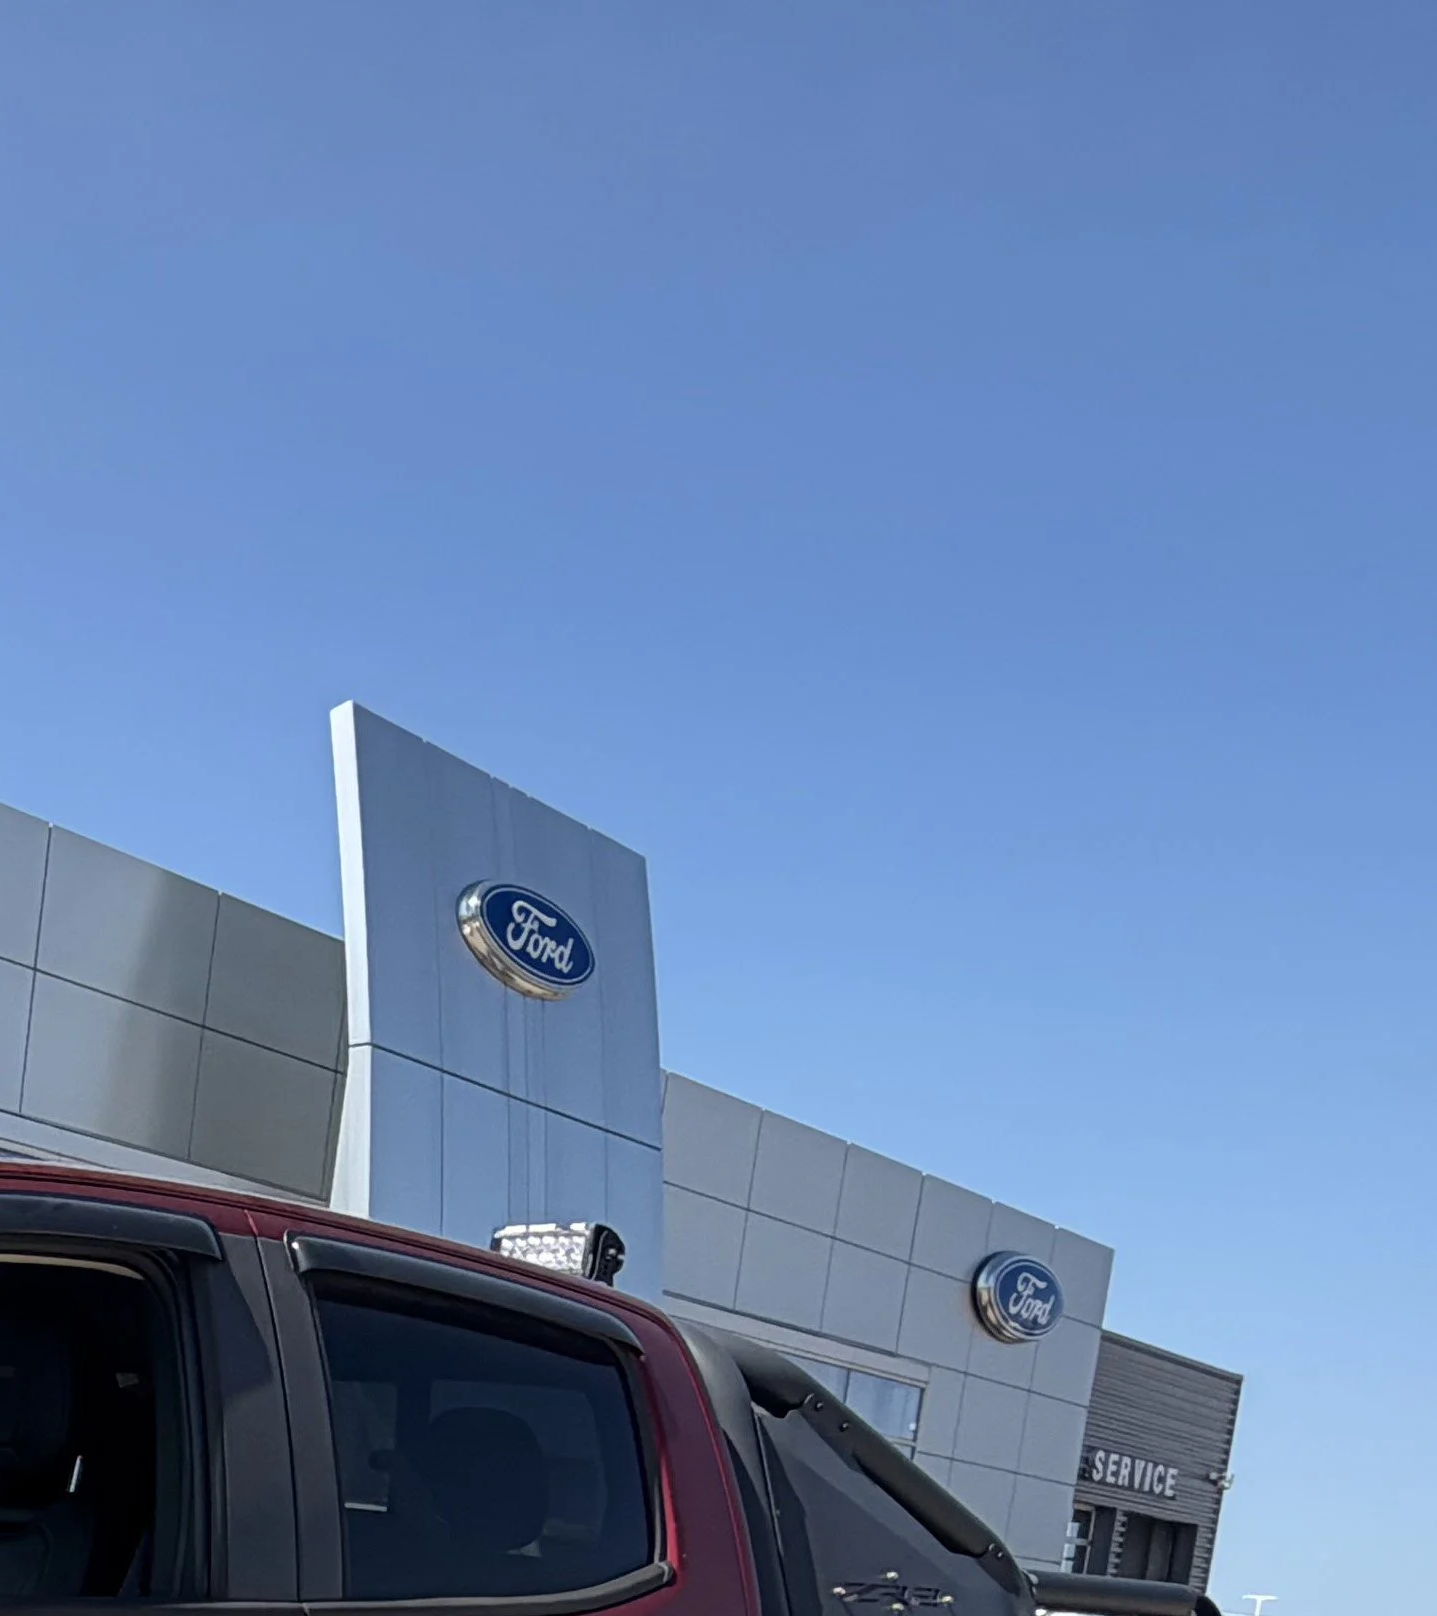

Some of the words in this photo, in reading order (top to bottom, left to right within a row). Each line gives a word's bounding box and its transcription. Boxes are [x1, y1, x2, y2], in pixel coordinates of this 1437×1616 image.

[506, 900, 574, 974] Ford
[1008, 1271, 1055, 1325] Ford
[1091, 1449, 1179, 1498] SERVICE
